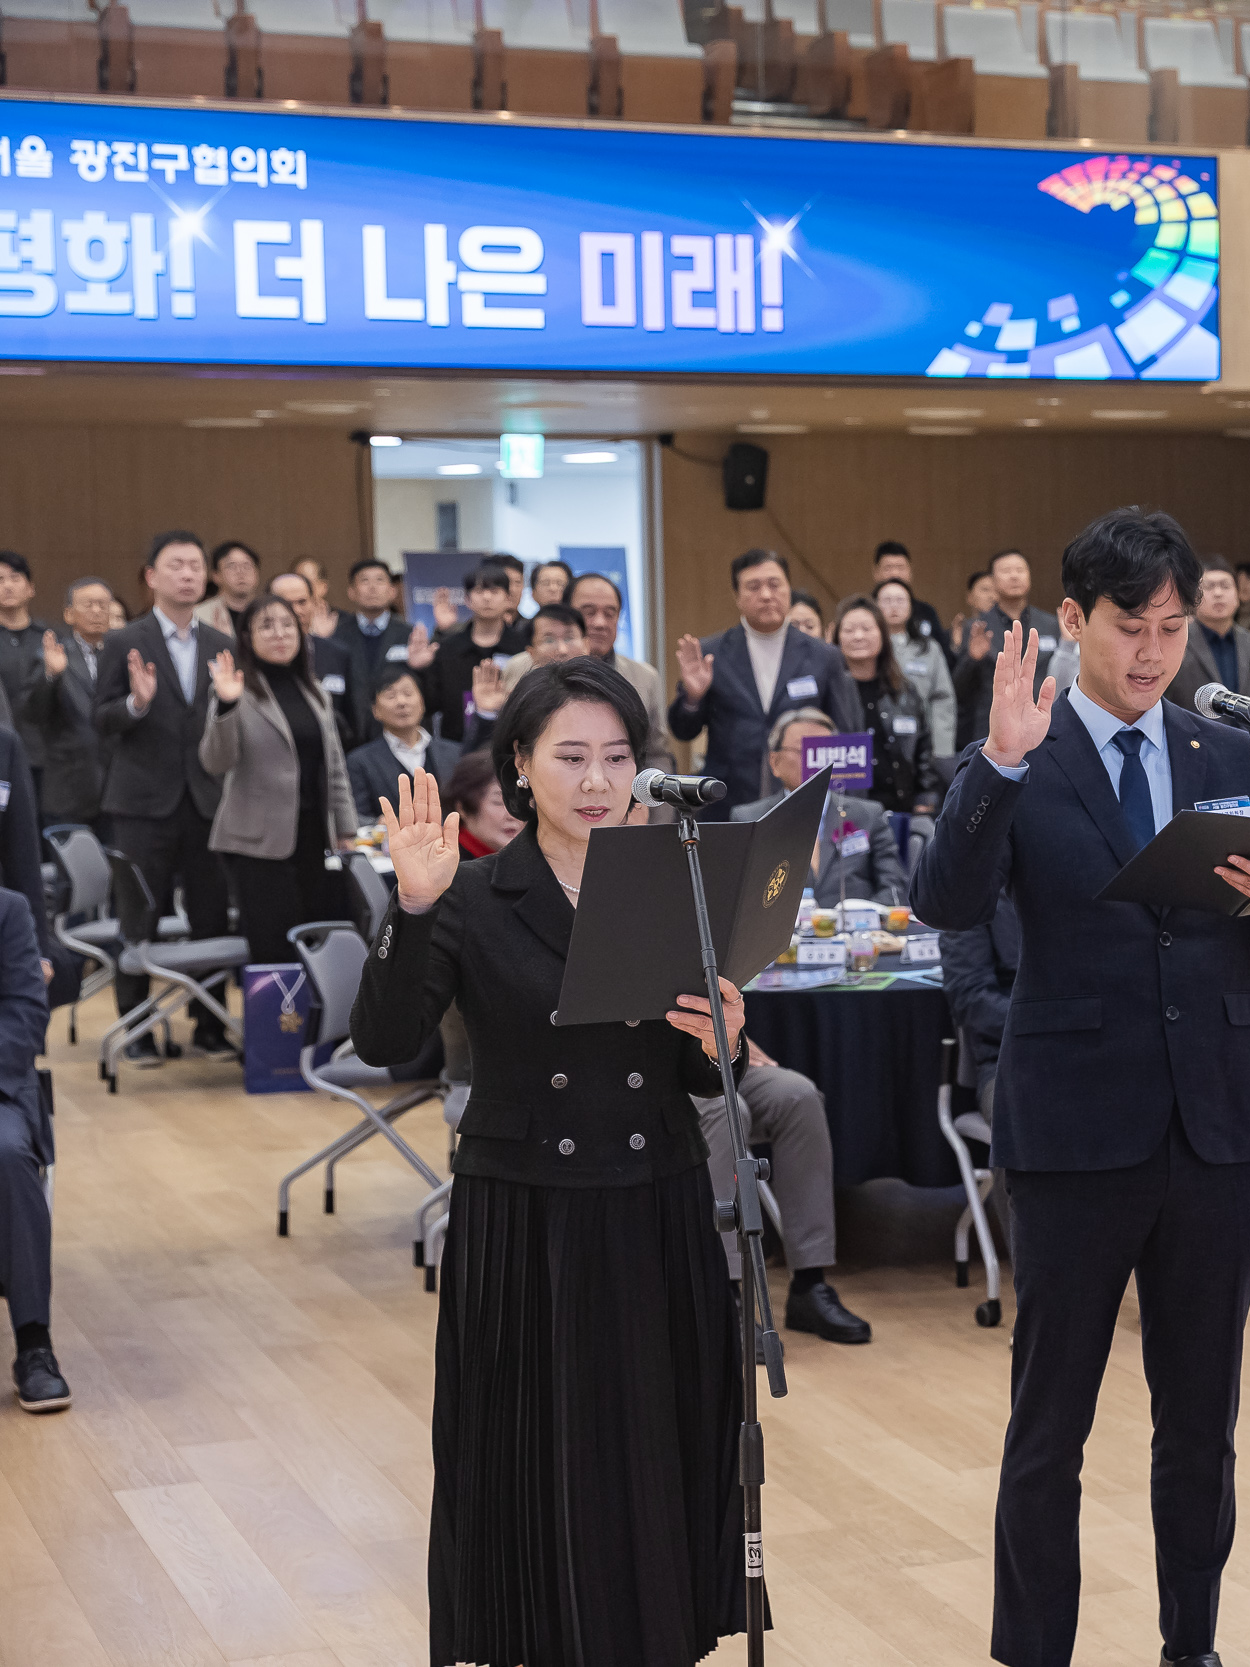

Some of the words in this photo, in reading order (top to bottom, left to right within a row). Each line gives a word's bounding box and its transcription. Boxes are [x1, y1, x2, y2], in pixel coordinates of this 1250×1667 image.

[0, 135, 53, 178] 울
[69, 140, 308, 189] 광진구협의회
[233, 218, 327, 325] 더
[362, 223, 548, 330] 나은
[579, 229, 784, 334] 미래!
